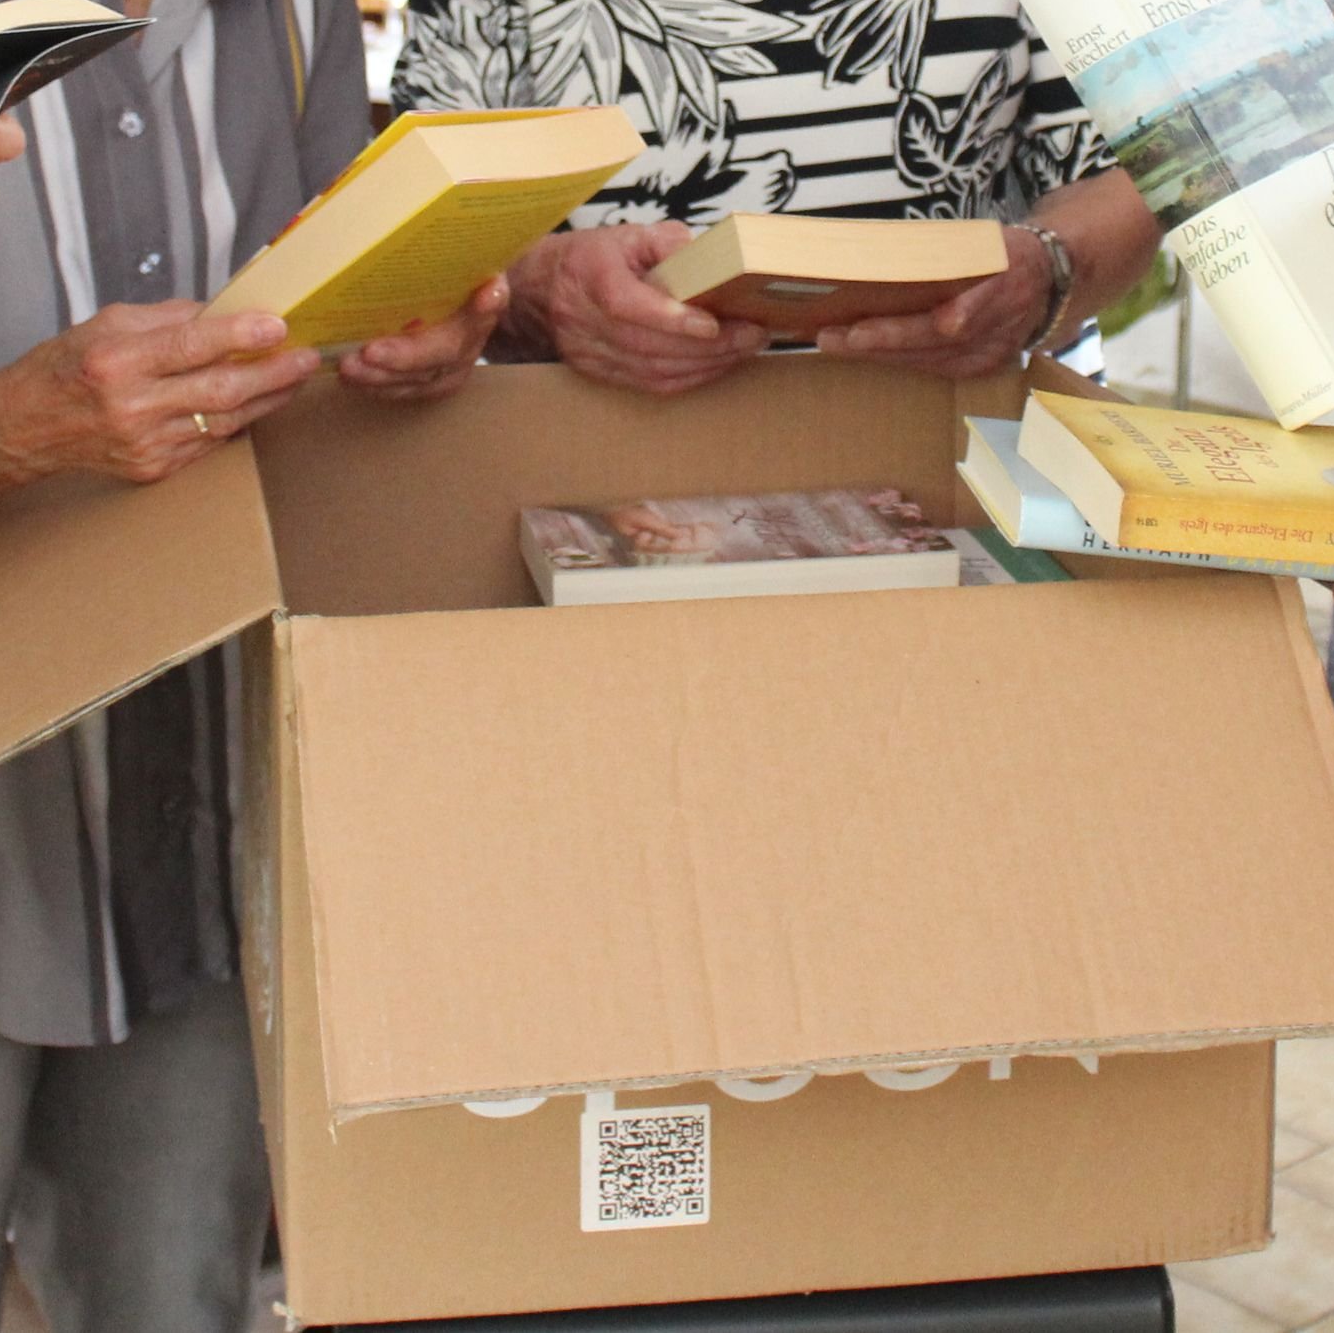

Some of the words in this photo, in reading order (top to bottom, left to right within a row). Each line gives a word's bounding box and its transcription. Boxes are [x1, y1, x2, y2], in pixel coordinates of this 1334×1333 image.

[1064, 30, 1130, 76] Wiechert
[1065, 24, 1106, 55] Ernst
[1182, 215, 1218, 245] Das
[1184, 224, 1247, 272] einfache
[1200, 250, 1251, 290] Leben
[1174, 426, 1257, 484] Eleganz
[1179, 518, 1208, 534] Igels
[1213, 520, 1235, 532] des
[1237, 524, 1288, 542] Eleganz
[1290, 529, 1314, 543] Die
